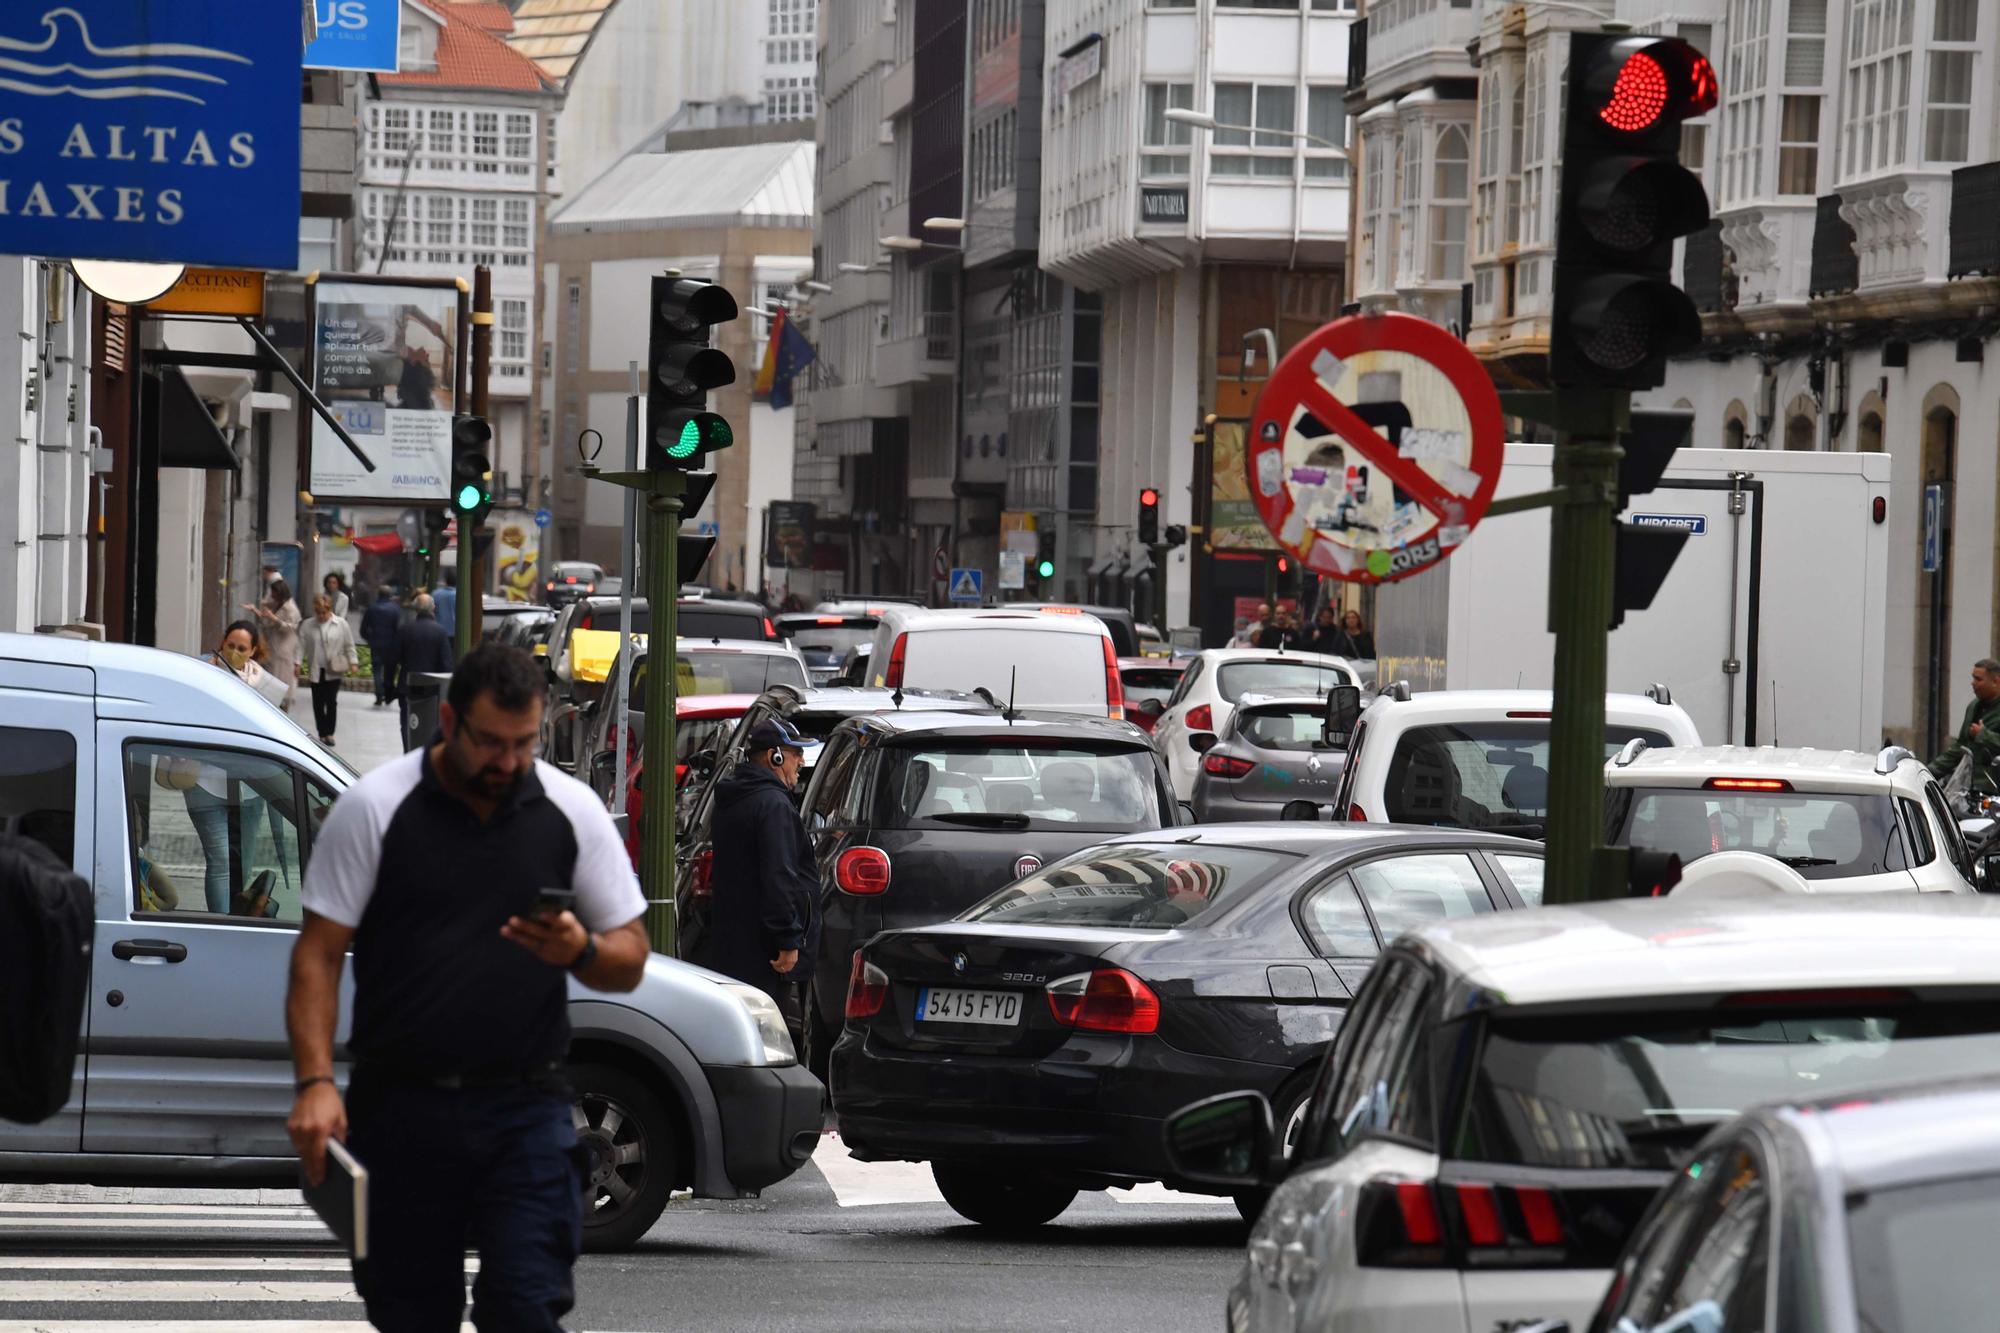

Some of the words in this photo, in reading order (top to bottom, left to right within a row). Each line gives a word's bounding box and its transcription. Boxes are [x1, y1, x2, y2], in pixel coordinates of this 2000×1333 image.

[59, 122, 256, 168] ALTAS
[324, 331, 361, 341] quieres
[332, 365, 354, 374] otro
[347, 407, 372, 429] tú
[1020, 864, 1037, 878] FIAT
[929, 991, 975, 1017] 5415
[979, 994, 1018, 1020] FYD
